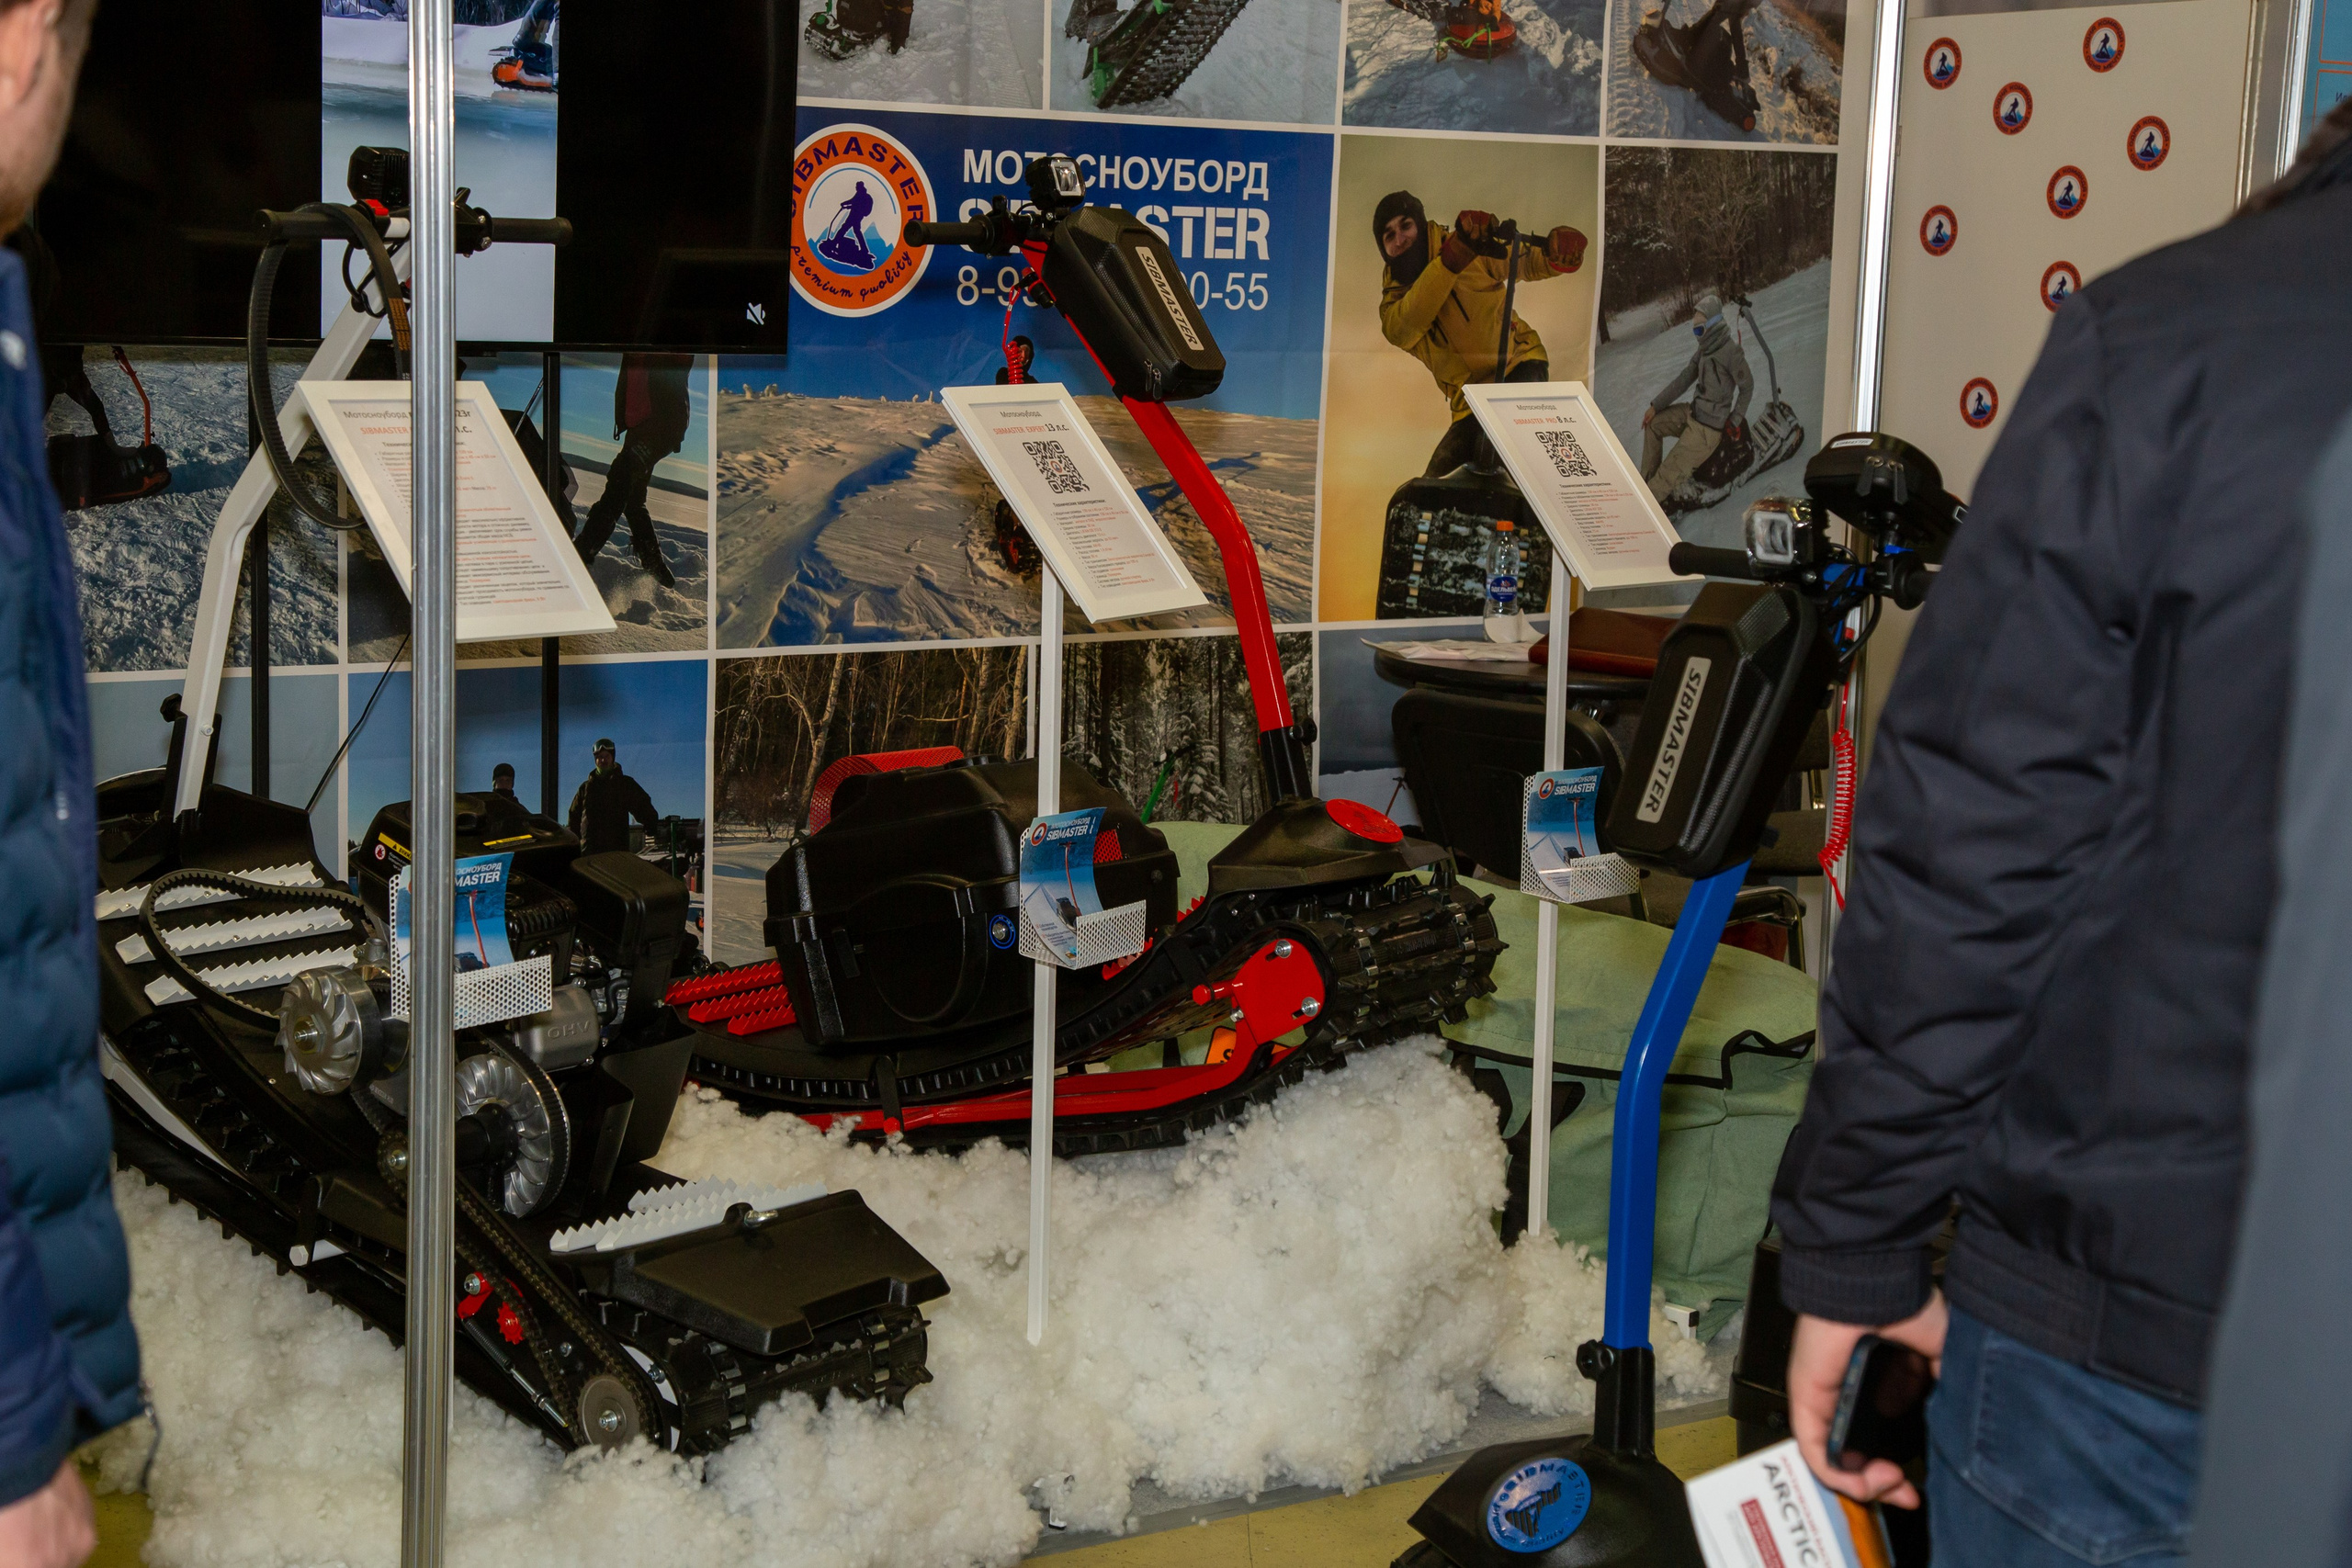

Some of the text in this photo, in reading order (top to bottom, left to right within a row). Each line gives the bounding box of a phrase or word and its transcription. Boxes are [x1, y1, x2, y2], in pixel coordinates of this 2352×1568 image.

[859, 250, 912, 302] quality
[1141, 254, 1198, 344] SIBMASTER
[343, 411, 408, 420] Мотосноуборд
[1513, 417, 1544, 425] SIBMASTER
[1556, 415, 1563, 423] 8
[360, 426, 408, 435] SIBMASTER
[992, 426, 1026, 435] SIBMASTER
[1025, 424, 1046, 434] EXPERT
[1046, 423, 1056, 432] 13
[1645, 667, 1702, 814] SIBMASTER
[1554, 783, 1596, 795] SIBMASTER
[1046, 825, 1089, 840] SIBMASTER
[455, 871, 501, 887] MASTER
[548, 1020, 589, 1040] OHV
